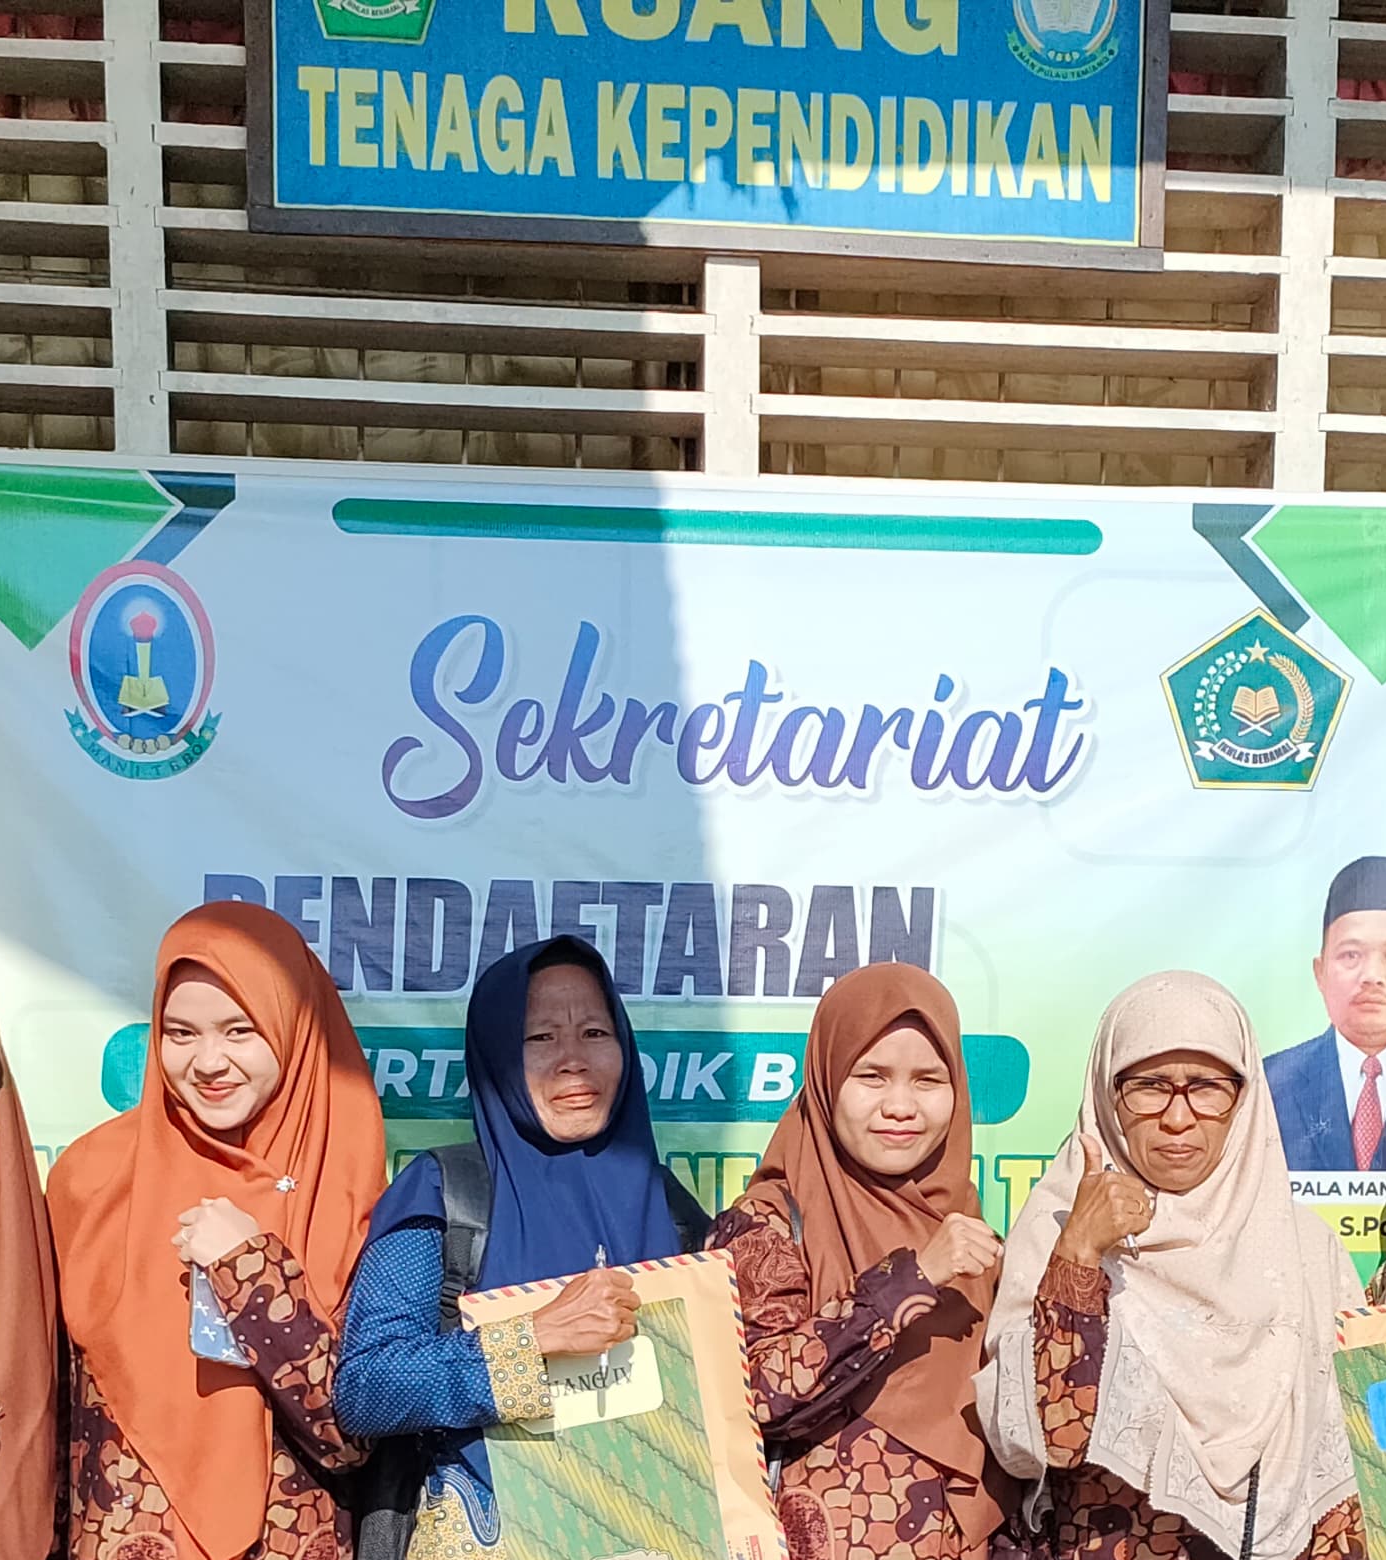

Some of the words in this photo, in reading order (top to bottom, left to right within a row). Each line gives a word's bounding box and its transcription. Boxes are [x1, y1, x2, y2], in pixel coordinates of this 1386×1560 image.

[298, 66, 576, 176] TENAGA
[597, 80, 1112, 204] KEPENDIDIKAN
[381, 615, 1084, 819] Sekretariat
[88, 743, 128, 773] MAN
[152, 744, 203, 776] TEBO
[204, 873, 935, 997] ENDAFTARAN
[1290, 1181, 1342, 1196] PALA
[547, 1370, 606, 1398] UANG
[613, 1361, 634, 1385] IV
